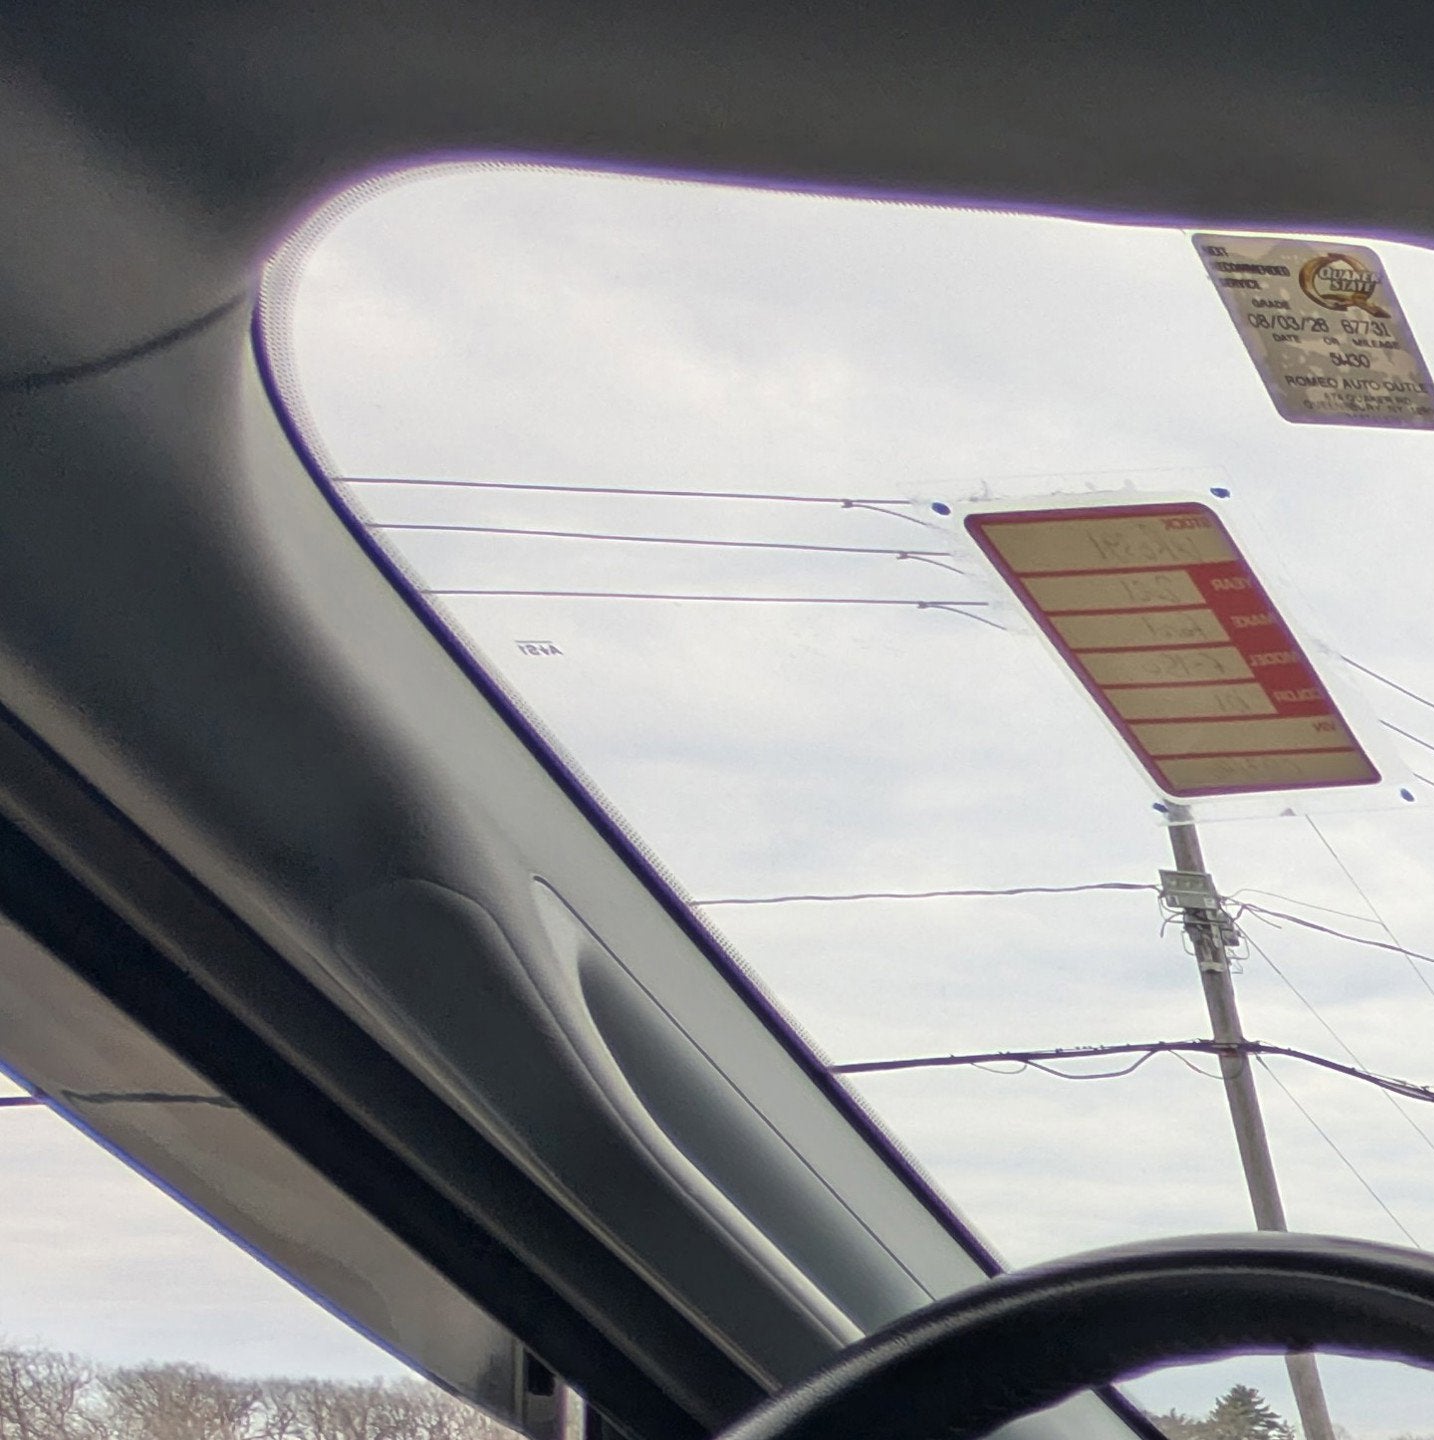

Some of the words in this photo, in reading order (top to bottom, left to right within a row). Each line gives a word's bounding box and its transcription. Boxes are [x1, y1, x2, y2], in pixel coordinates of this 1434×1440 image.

[1331, 353, 1371, 368] 5W30
[1285, 375, 1339, 389] ROMEO
[1343, 379, 1381, 392] AUTO
